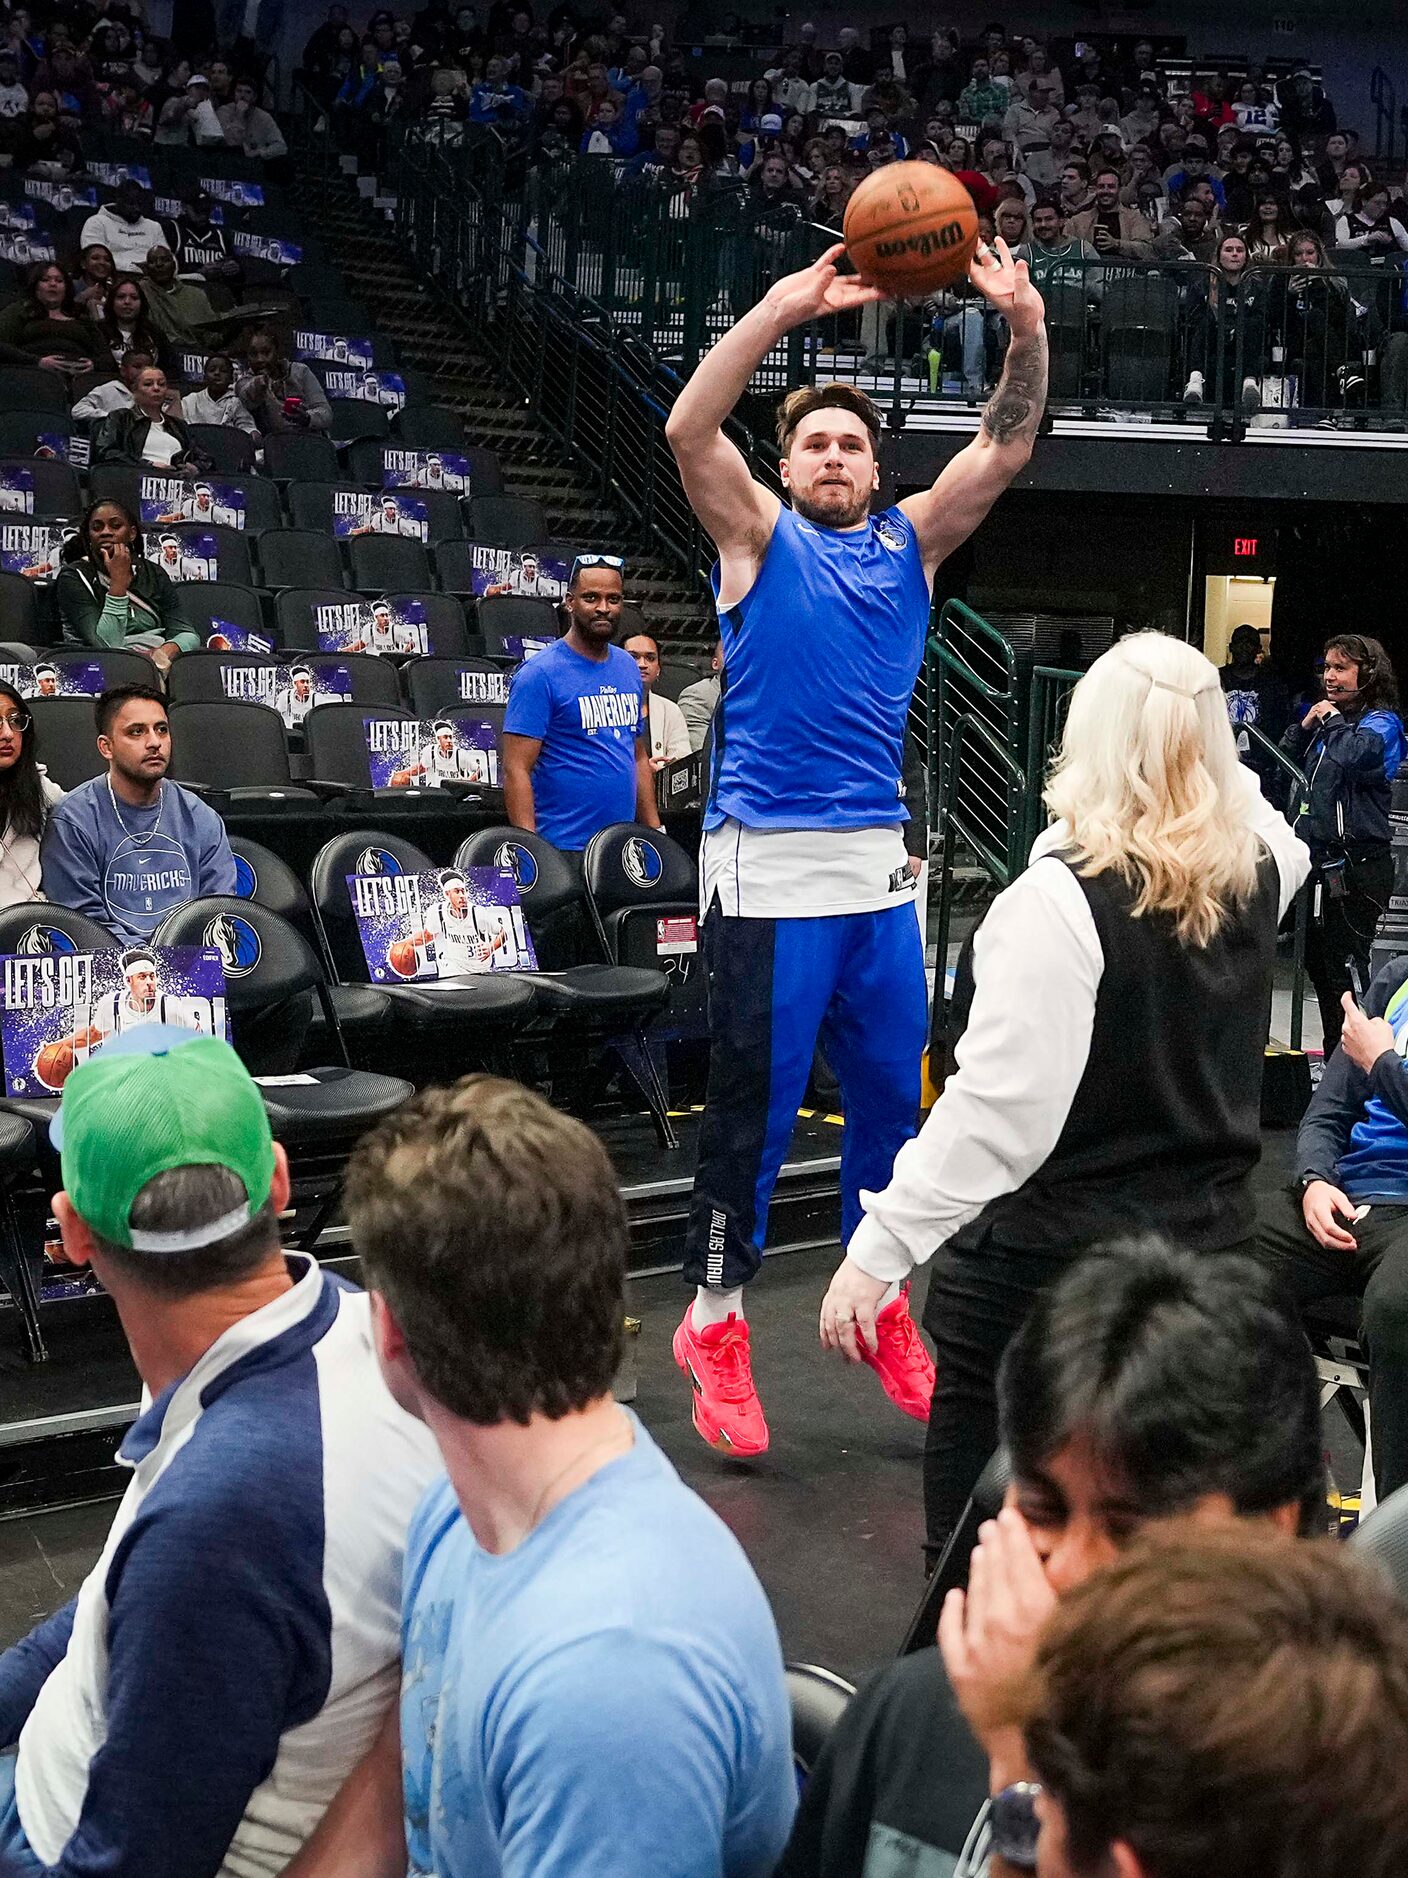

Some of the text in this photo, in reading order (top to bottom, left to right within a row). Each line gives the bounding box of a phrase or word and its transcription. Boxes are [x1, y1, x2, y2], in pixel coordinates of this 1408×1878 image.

[876, 221, 964, 258] Wilson
[297, 332, 314, 350] LET'S
[325, 371, 343, 390] LET'S
[384, 450, 418, 471] LET'S GET
[142, 477, 184, 501] LET'S GET
[335, 493, 373, 515] LET'S GET
[2, 526, 50, 552] LET'S GET
[1234, 538, 1258, 556] EXIT
[473, 546, 511, 571] LET'S GET
[317, 604, 360, 632] LET'S GET
[227, 667, 277, 697] LET'S GET
[461, 673, 504, 700] LET'S GET
[370, 721, 421, 752] LET'S GET
[113, 869, 186, 892] MAVERICKS
[355, 874, 421, 918] LET'S GET
[5, 955, 94, 1010] LET'S GET
[709, 1209, 727, 1251] DALLAS
